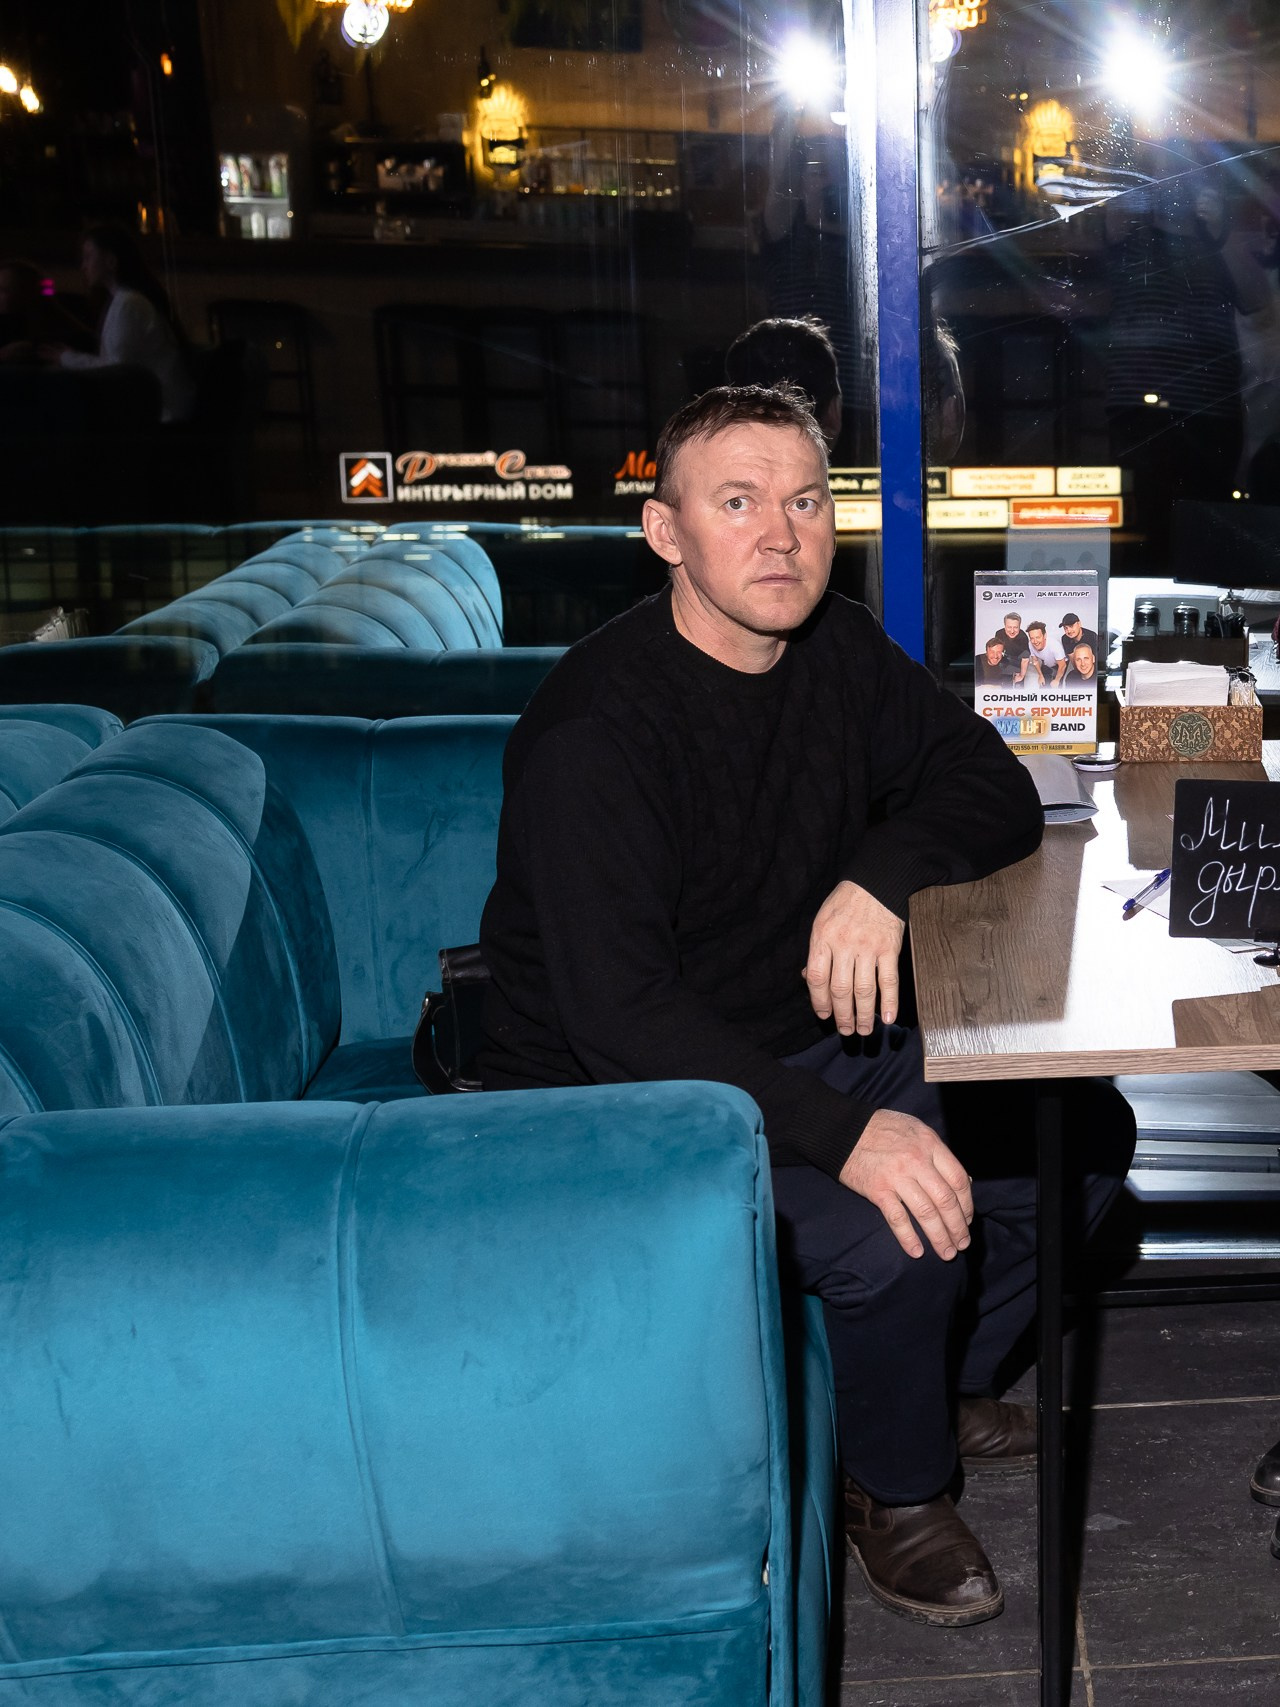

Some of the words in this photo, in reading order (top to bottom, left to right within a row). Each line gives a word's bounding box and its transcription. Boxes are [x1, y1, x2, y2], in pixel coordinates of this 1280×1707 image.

[396, 481, 526, 502] ИНТЕРЬЕРНЫЙ
[982, 590, 993, 601] 9
[983, 693, 1038, 702] СОЛЬНЫЙ
[1040, 694, 1093, 703] КОНЦЕРТ
[982, 707, 1026, 717] СТАС
[1030, 707, 1092, 717] ЯРУШИН
[1050, 723, 1086, 732] BAND
